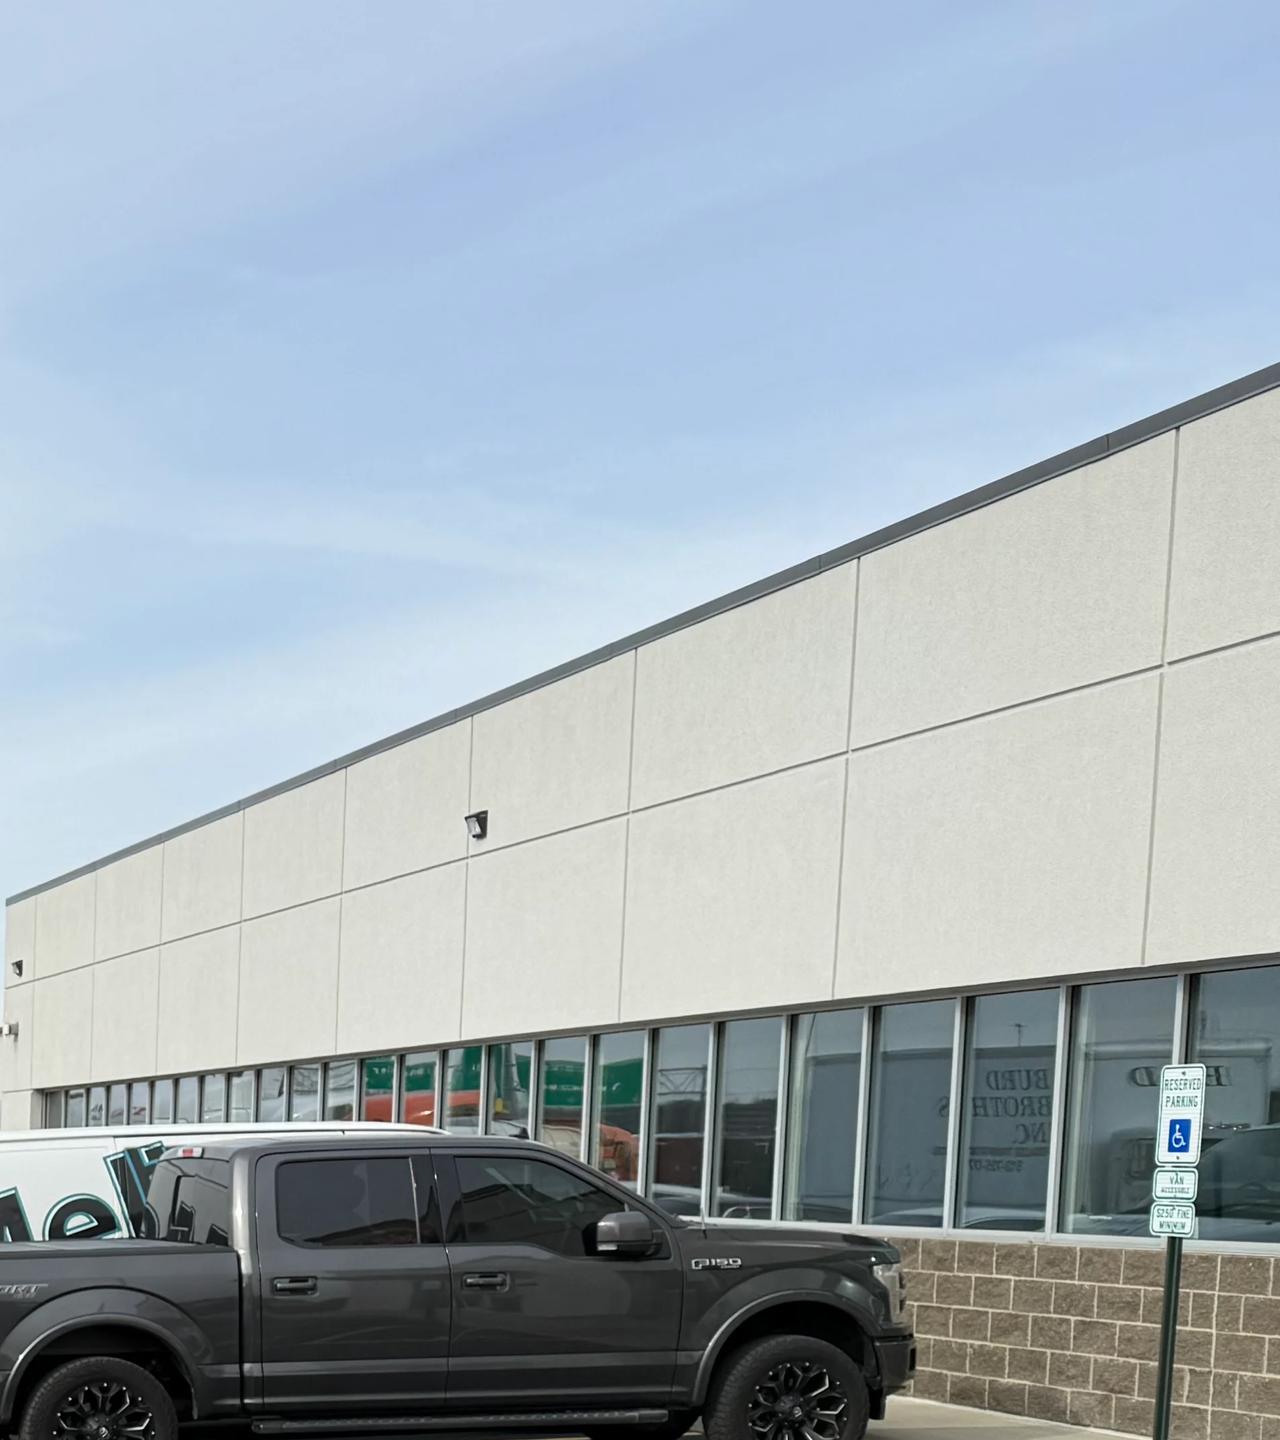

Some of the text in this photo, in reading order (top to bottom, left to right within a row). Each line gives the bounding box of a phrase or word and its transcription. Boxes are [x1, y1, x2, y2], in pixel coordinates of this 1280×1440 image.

[1164, 1077, 1202, 1092] RESERVED
[1165, 1095, 1199, 1108] PARKING
[1169, 1175, 1185, 1185] VAN
[1177, 1207, 1190, 1219] FINE
